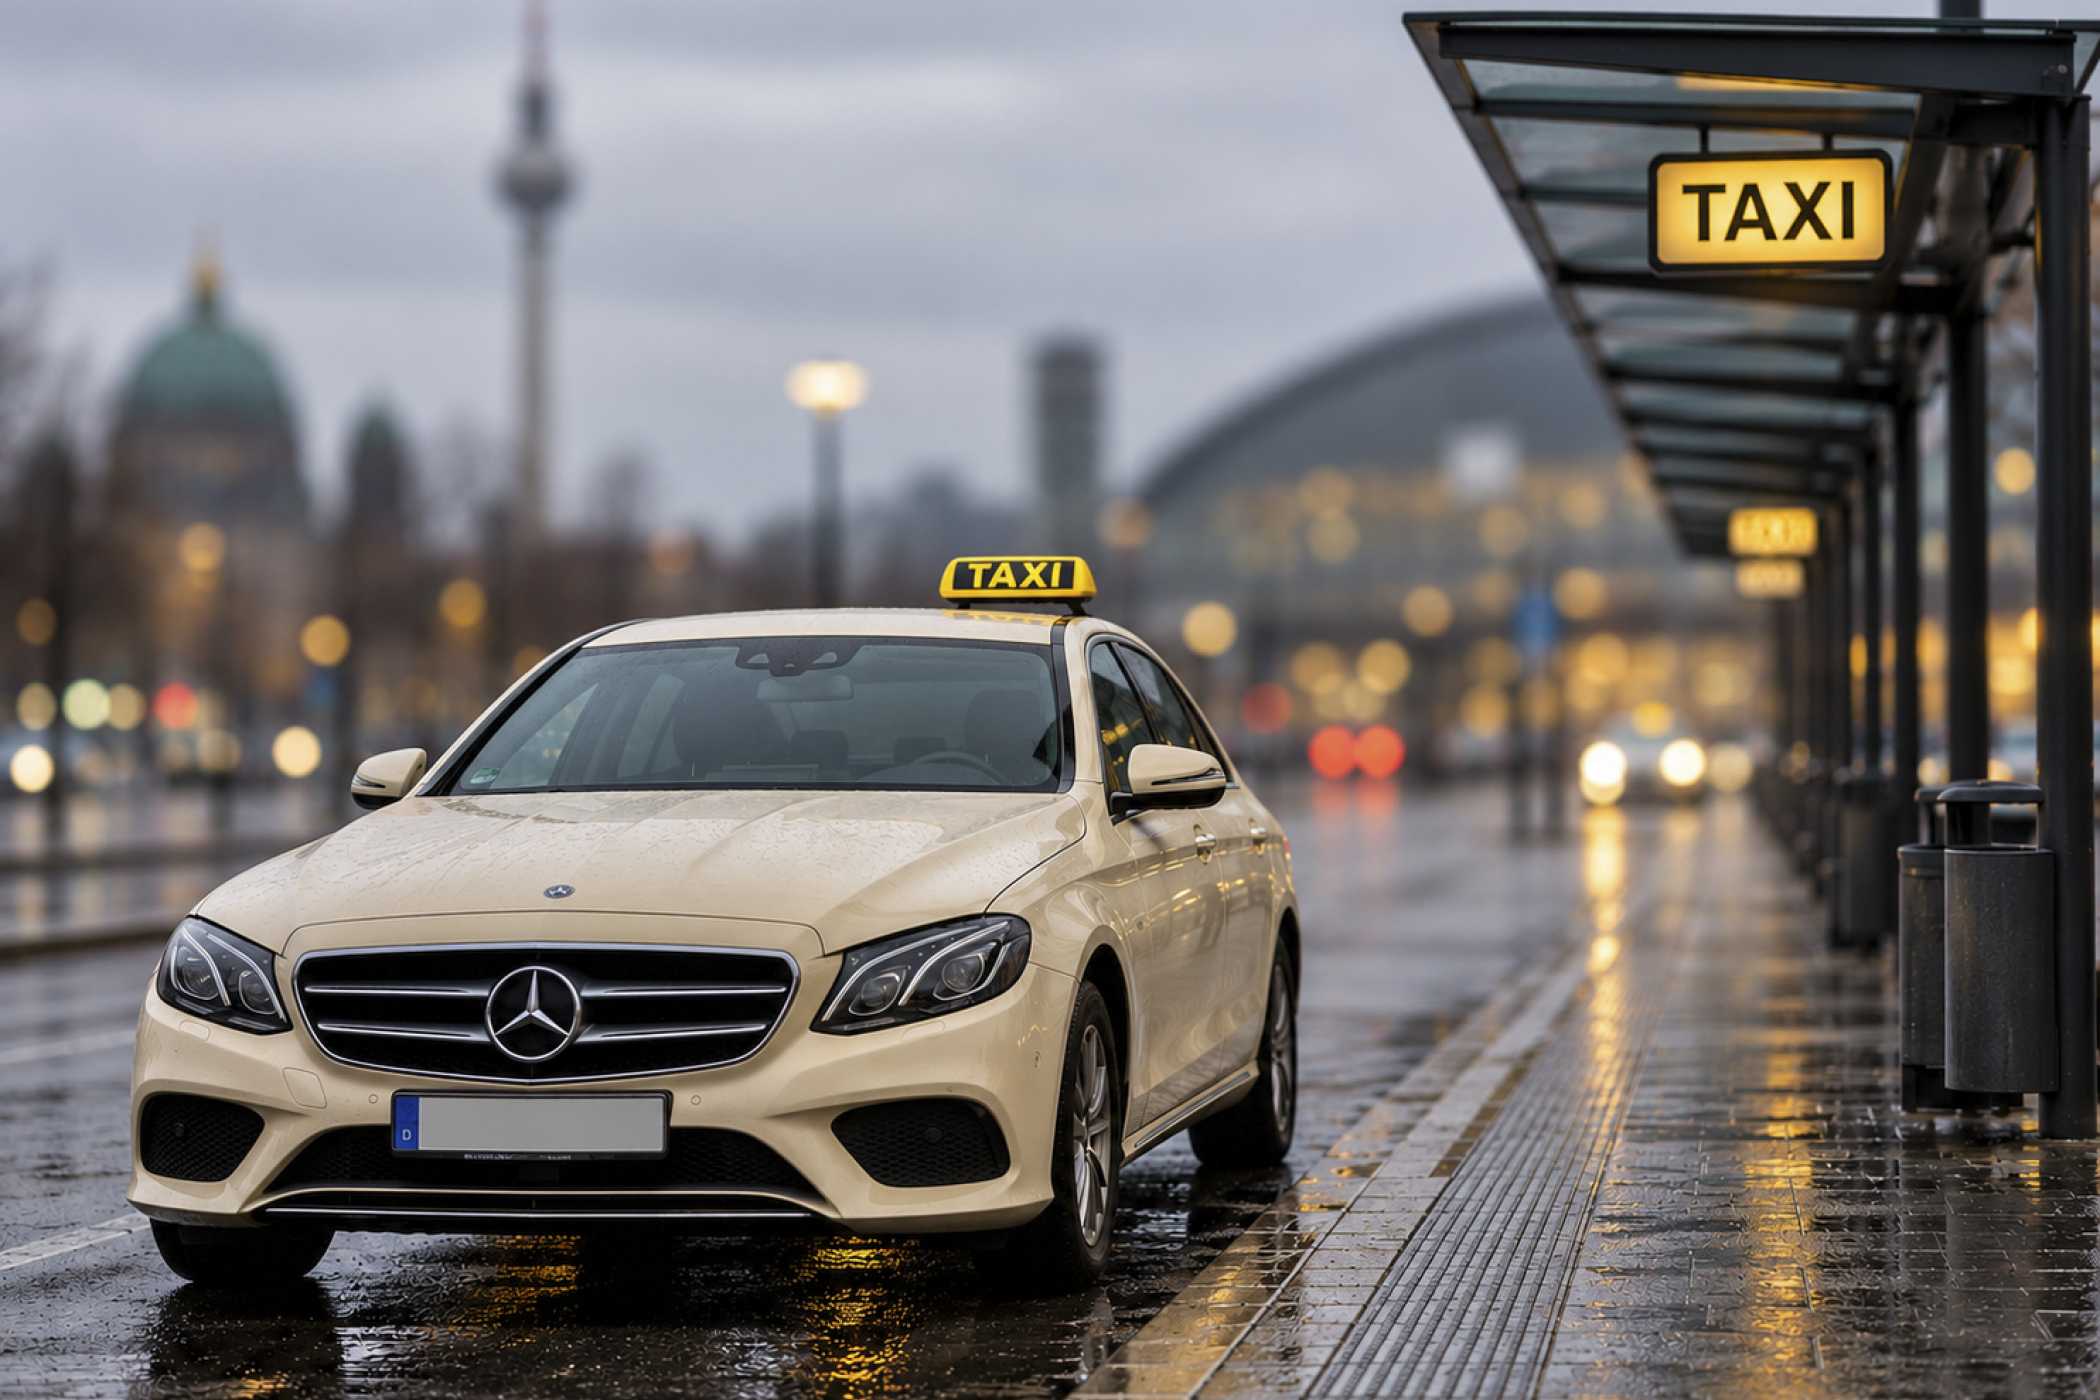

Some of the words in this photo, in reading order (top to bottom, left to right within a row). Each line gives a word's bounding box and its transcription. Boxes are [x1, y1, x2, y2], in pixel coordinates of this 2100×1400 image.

[1682, 181, 1855, 242] TAXI
[968, 562, 1062, 588] TAXI
[402, 1129, 412, 1141] D
